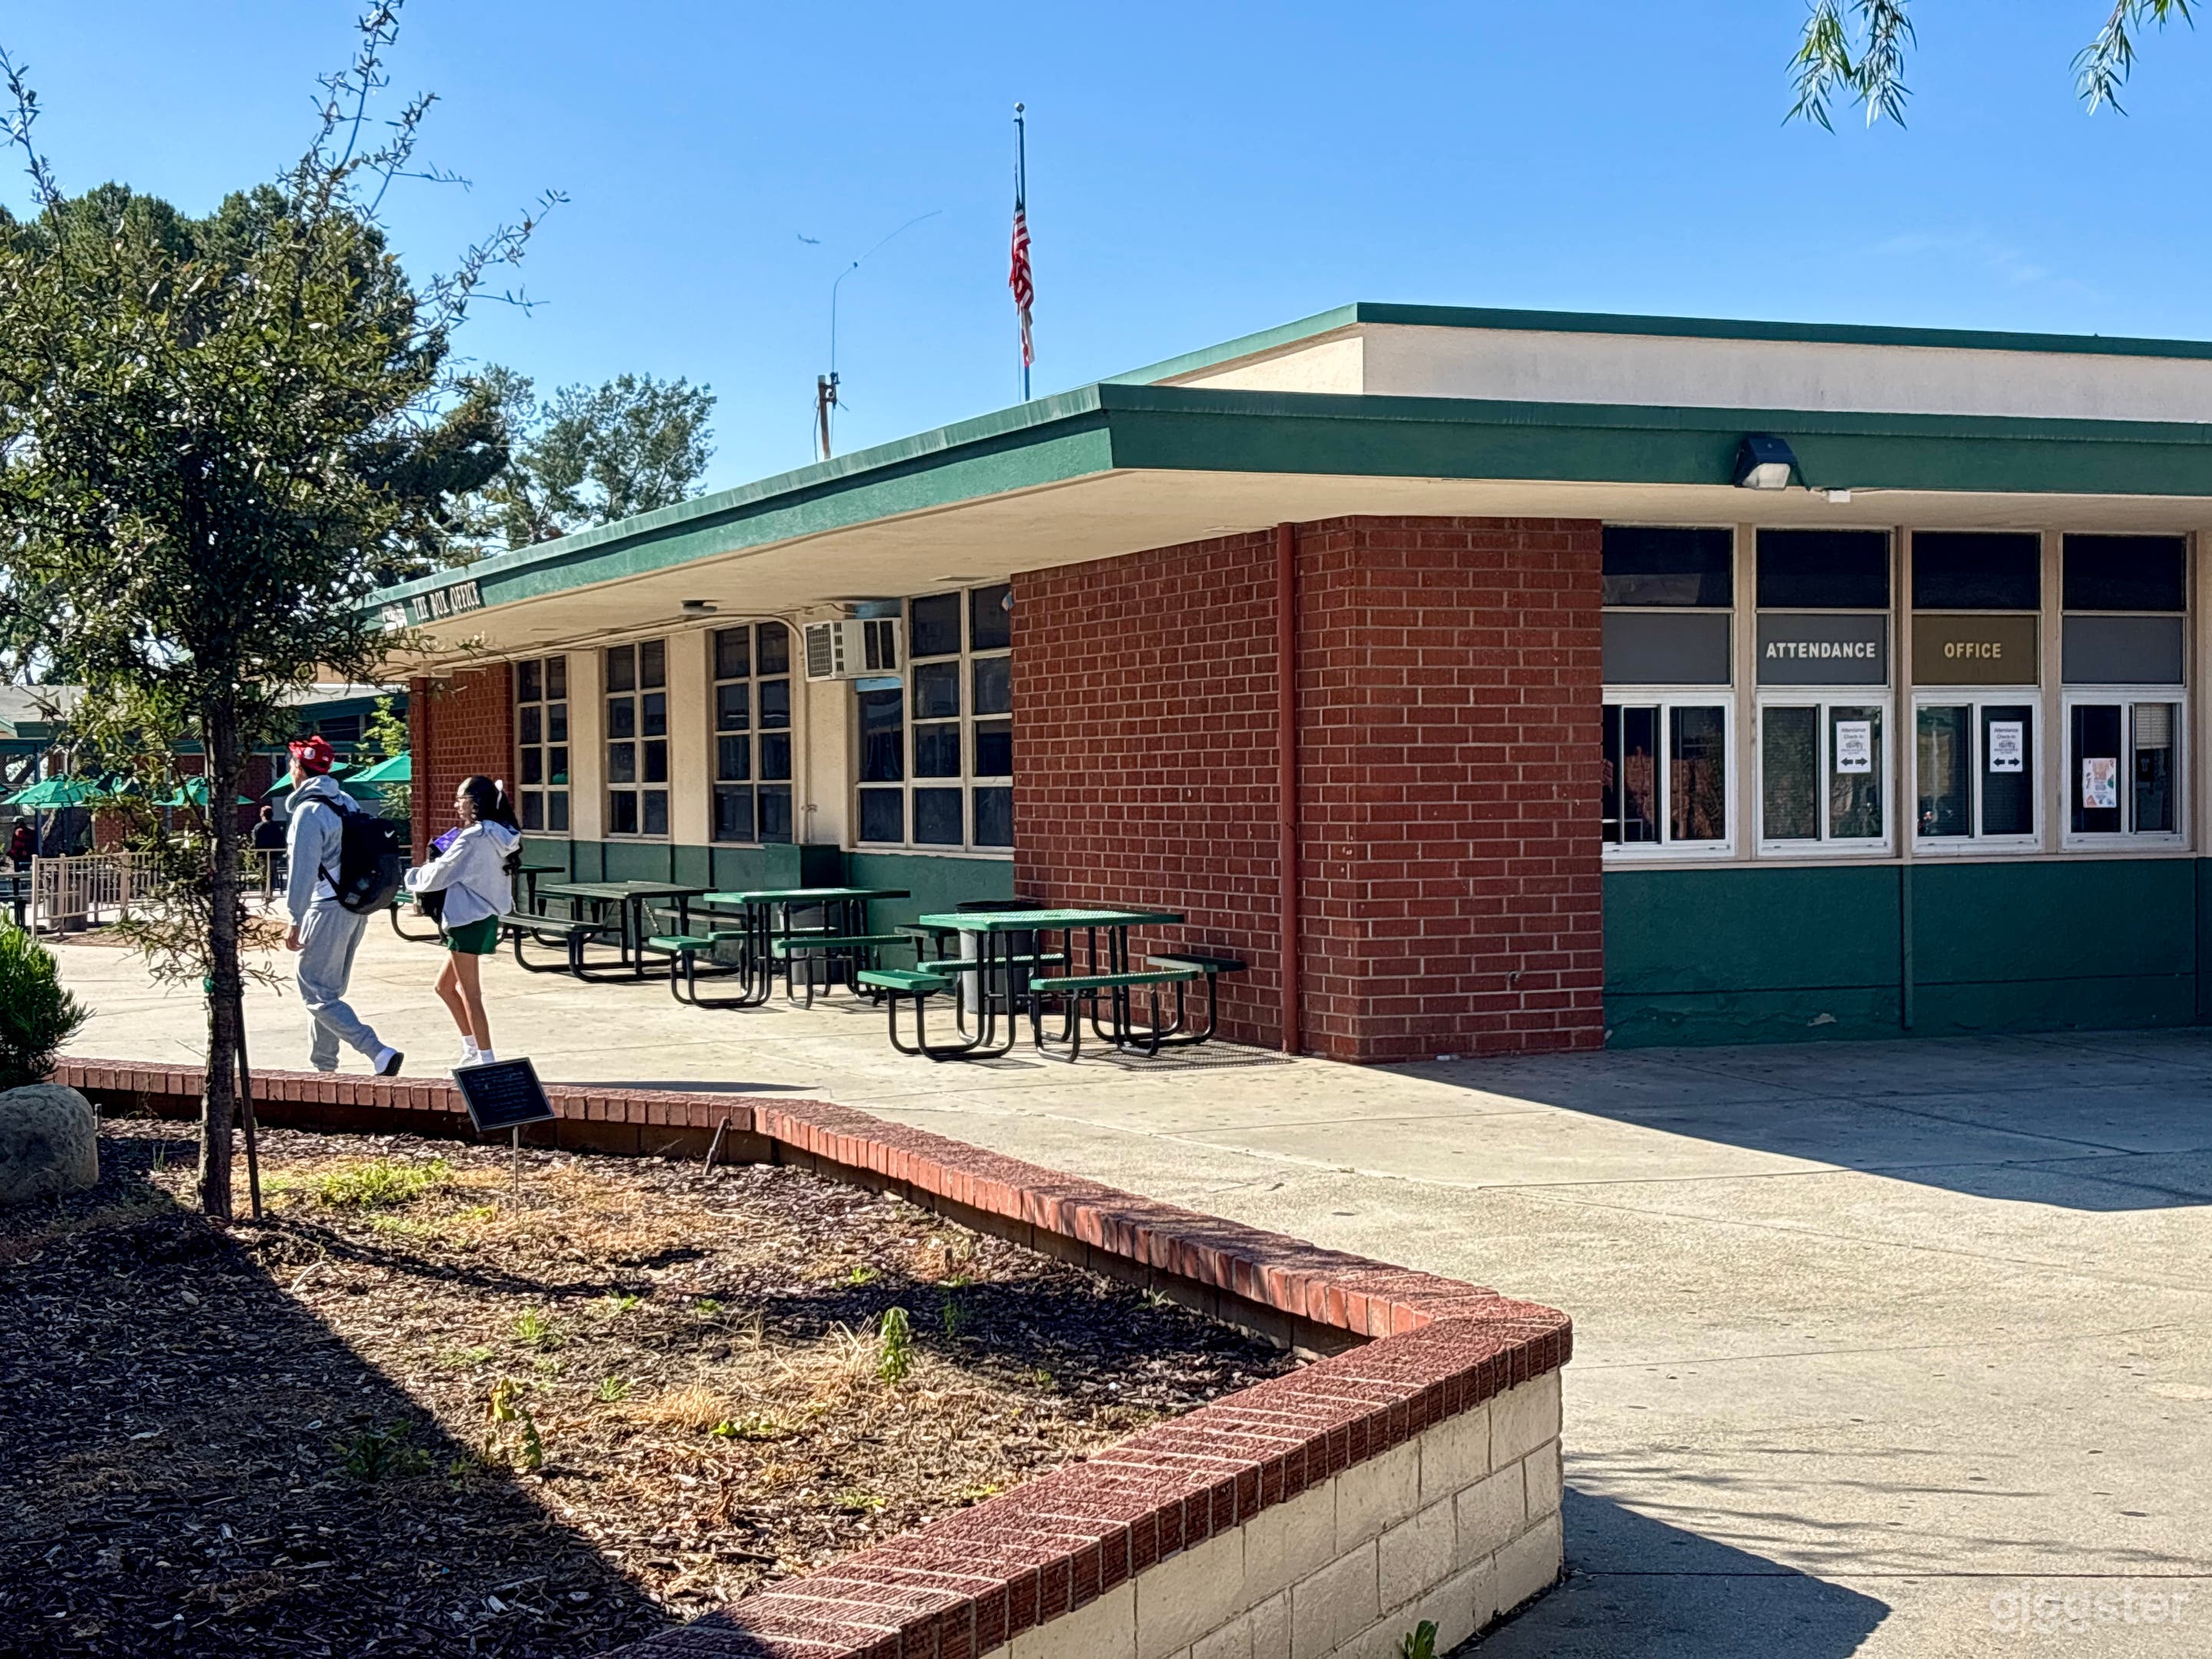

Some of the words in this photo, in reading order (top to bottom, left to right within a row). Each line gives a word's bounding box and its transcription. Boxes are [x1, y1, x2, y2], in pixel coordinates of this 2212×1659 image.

[412, 596, 429, 621] THE
[429, 591, 450, 616] BOX
[449, 581, 480, 611] OFFICE
[1766, 642, 1876, 658] ATTENDANCE
[1944, 642, 2002, 658] OFFICE
